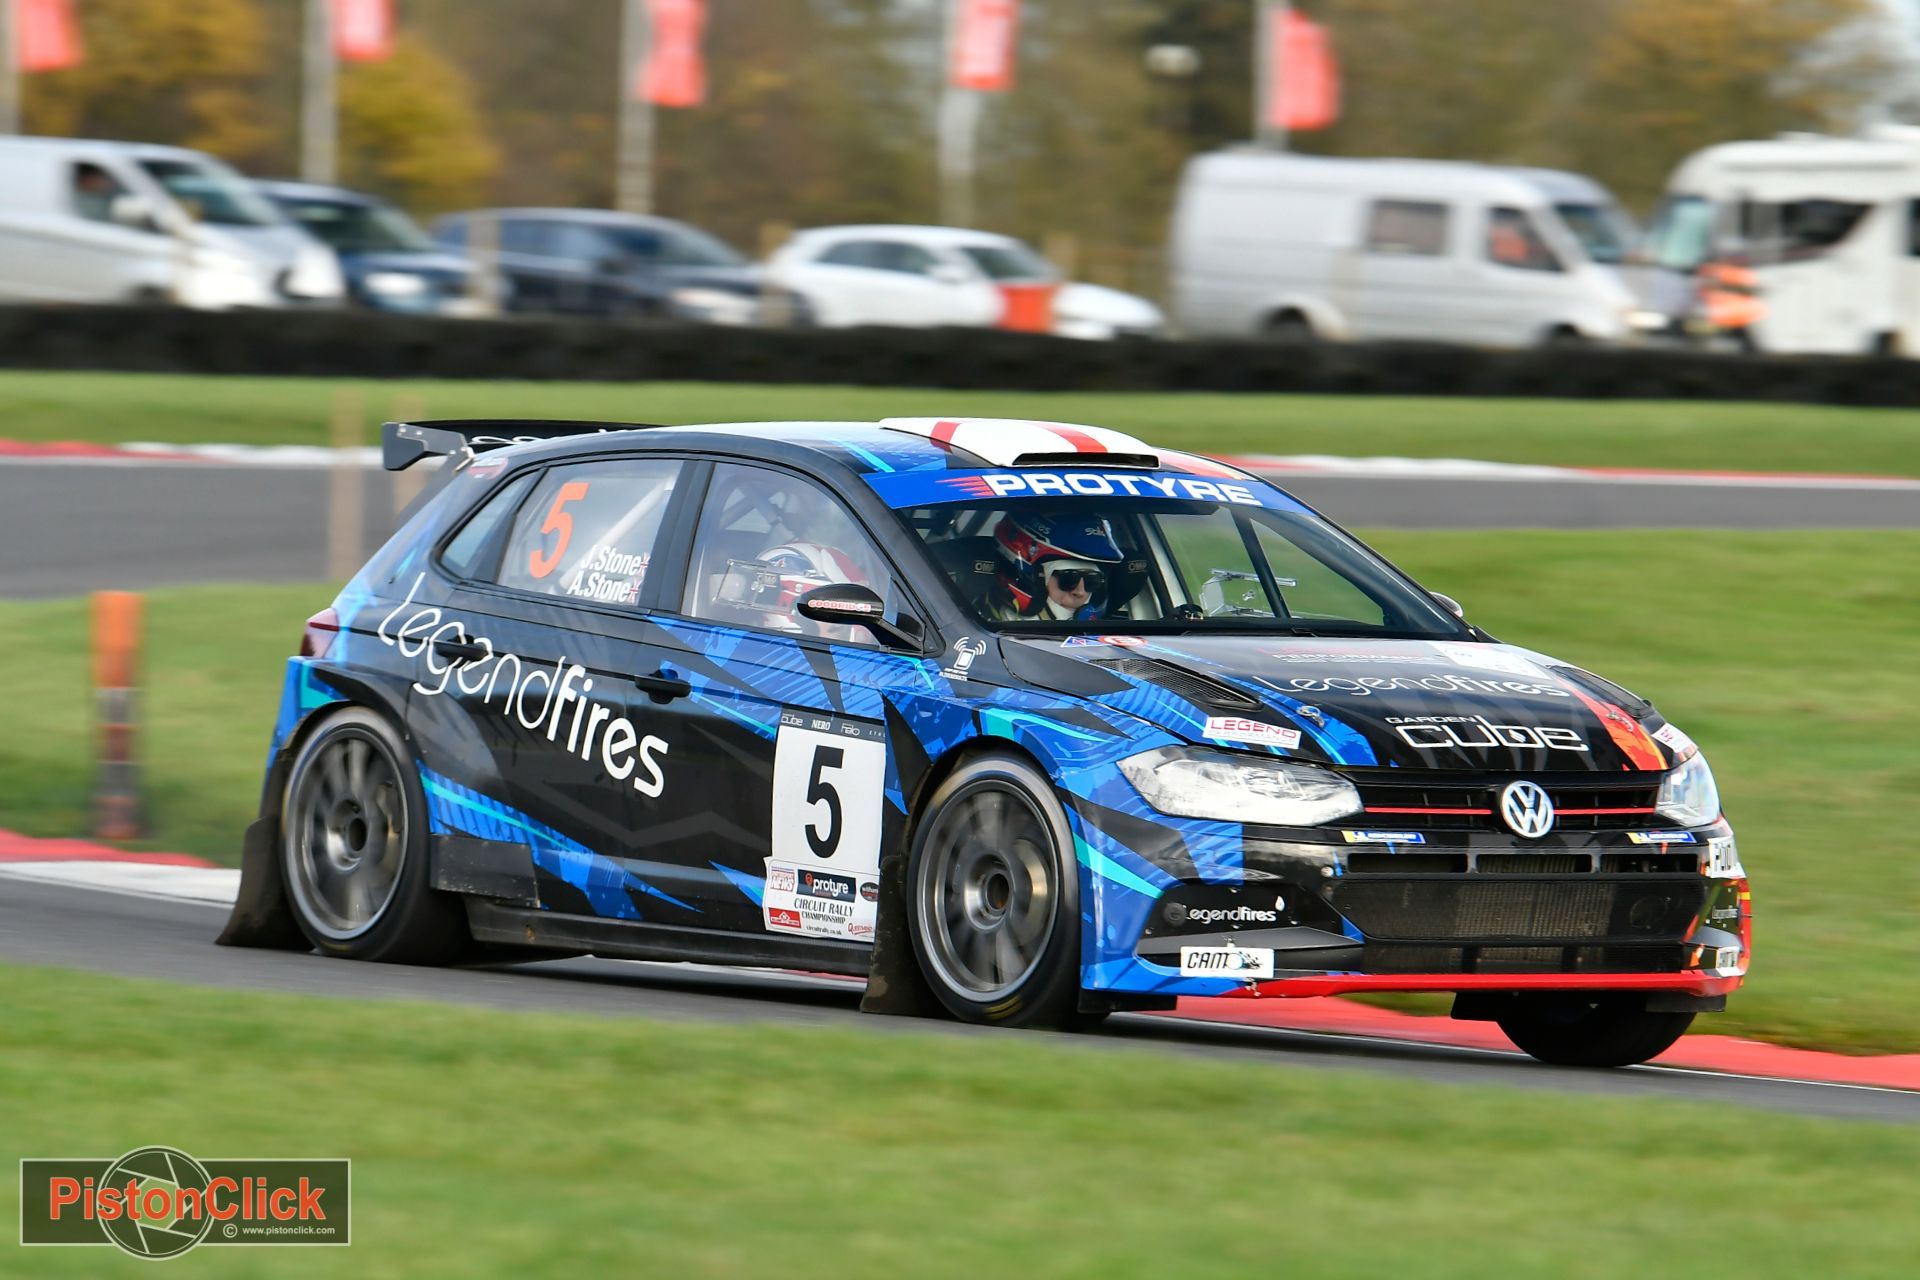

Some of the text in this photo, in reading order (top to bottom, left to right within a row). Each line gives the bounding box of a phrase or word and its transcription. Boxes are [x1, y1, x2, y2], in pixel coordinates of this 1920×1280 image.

[981, 473, 1264, 507] PROTYRE
[529, 481, 591, 578] 5
[580, 543, 642, 577] J.Stone
[566, 570, 633, 603] A.Stone
[377, 571, 669, 798] Legendfires
[1253, 674, 1570, 697] Legendfires
[811, 719, 831, 731] NERO
[1210, 719, 1297, 739] LEGEND
[1384, 716, 1476, 724] GARDEN
[1395, 715, 1590, 751] cube
[804, 744, 844, 859] 5
[813, 878, 848, 897] protyre
[794, 897, 855, 917] CIRCUIT RALLY
[801, 911, 846, 924] CHAMPIONSHIP
